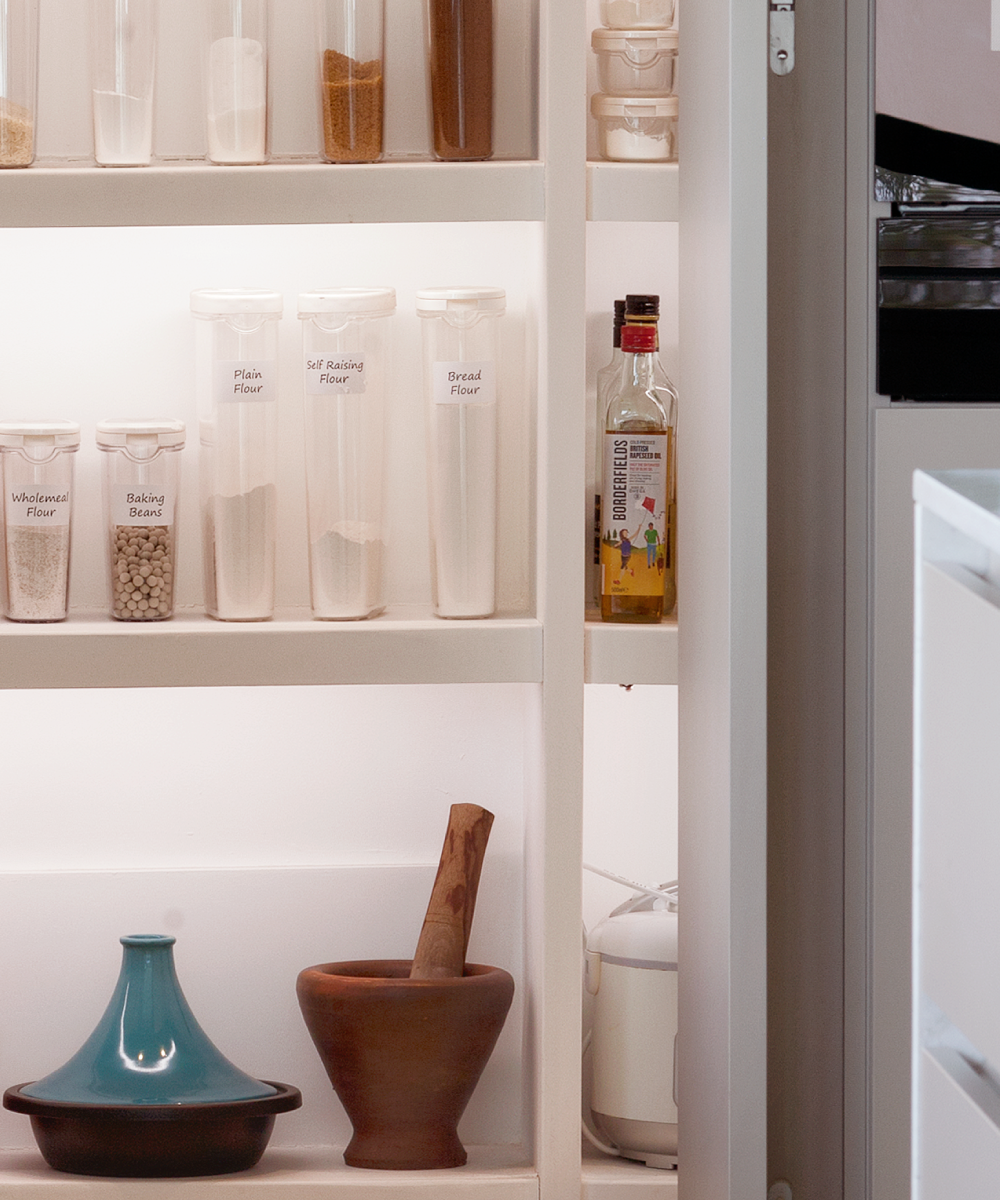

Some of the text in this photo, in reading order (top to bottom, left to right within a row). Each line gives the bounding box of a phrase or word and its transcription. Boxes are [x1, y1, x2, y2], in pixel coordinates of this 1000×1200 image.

[307, 359, 363, 372] Self Raising
[234, 369, 262, 379] Plain
[320, 373, 349, 383] Flour
[448, 370, 481, 381] Bread
[234, 383, 263, 393] Flour
[451, 385, 480, 395] Flour
[613, 440, 628, 520] BORDERFIELDS
[12, 492, 68, 503] Wholemeal
[127, 493, 164, 506] Baking
[27, 506, 56, 517] Flour
[130, 507, 162, 517] Beans
